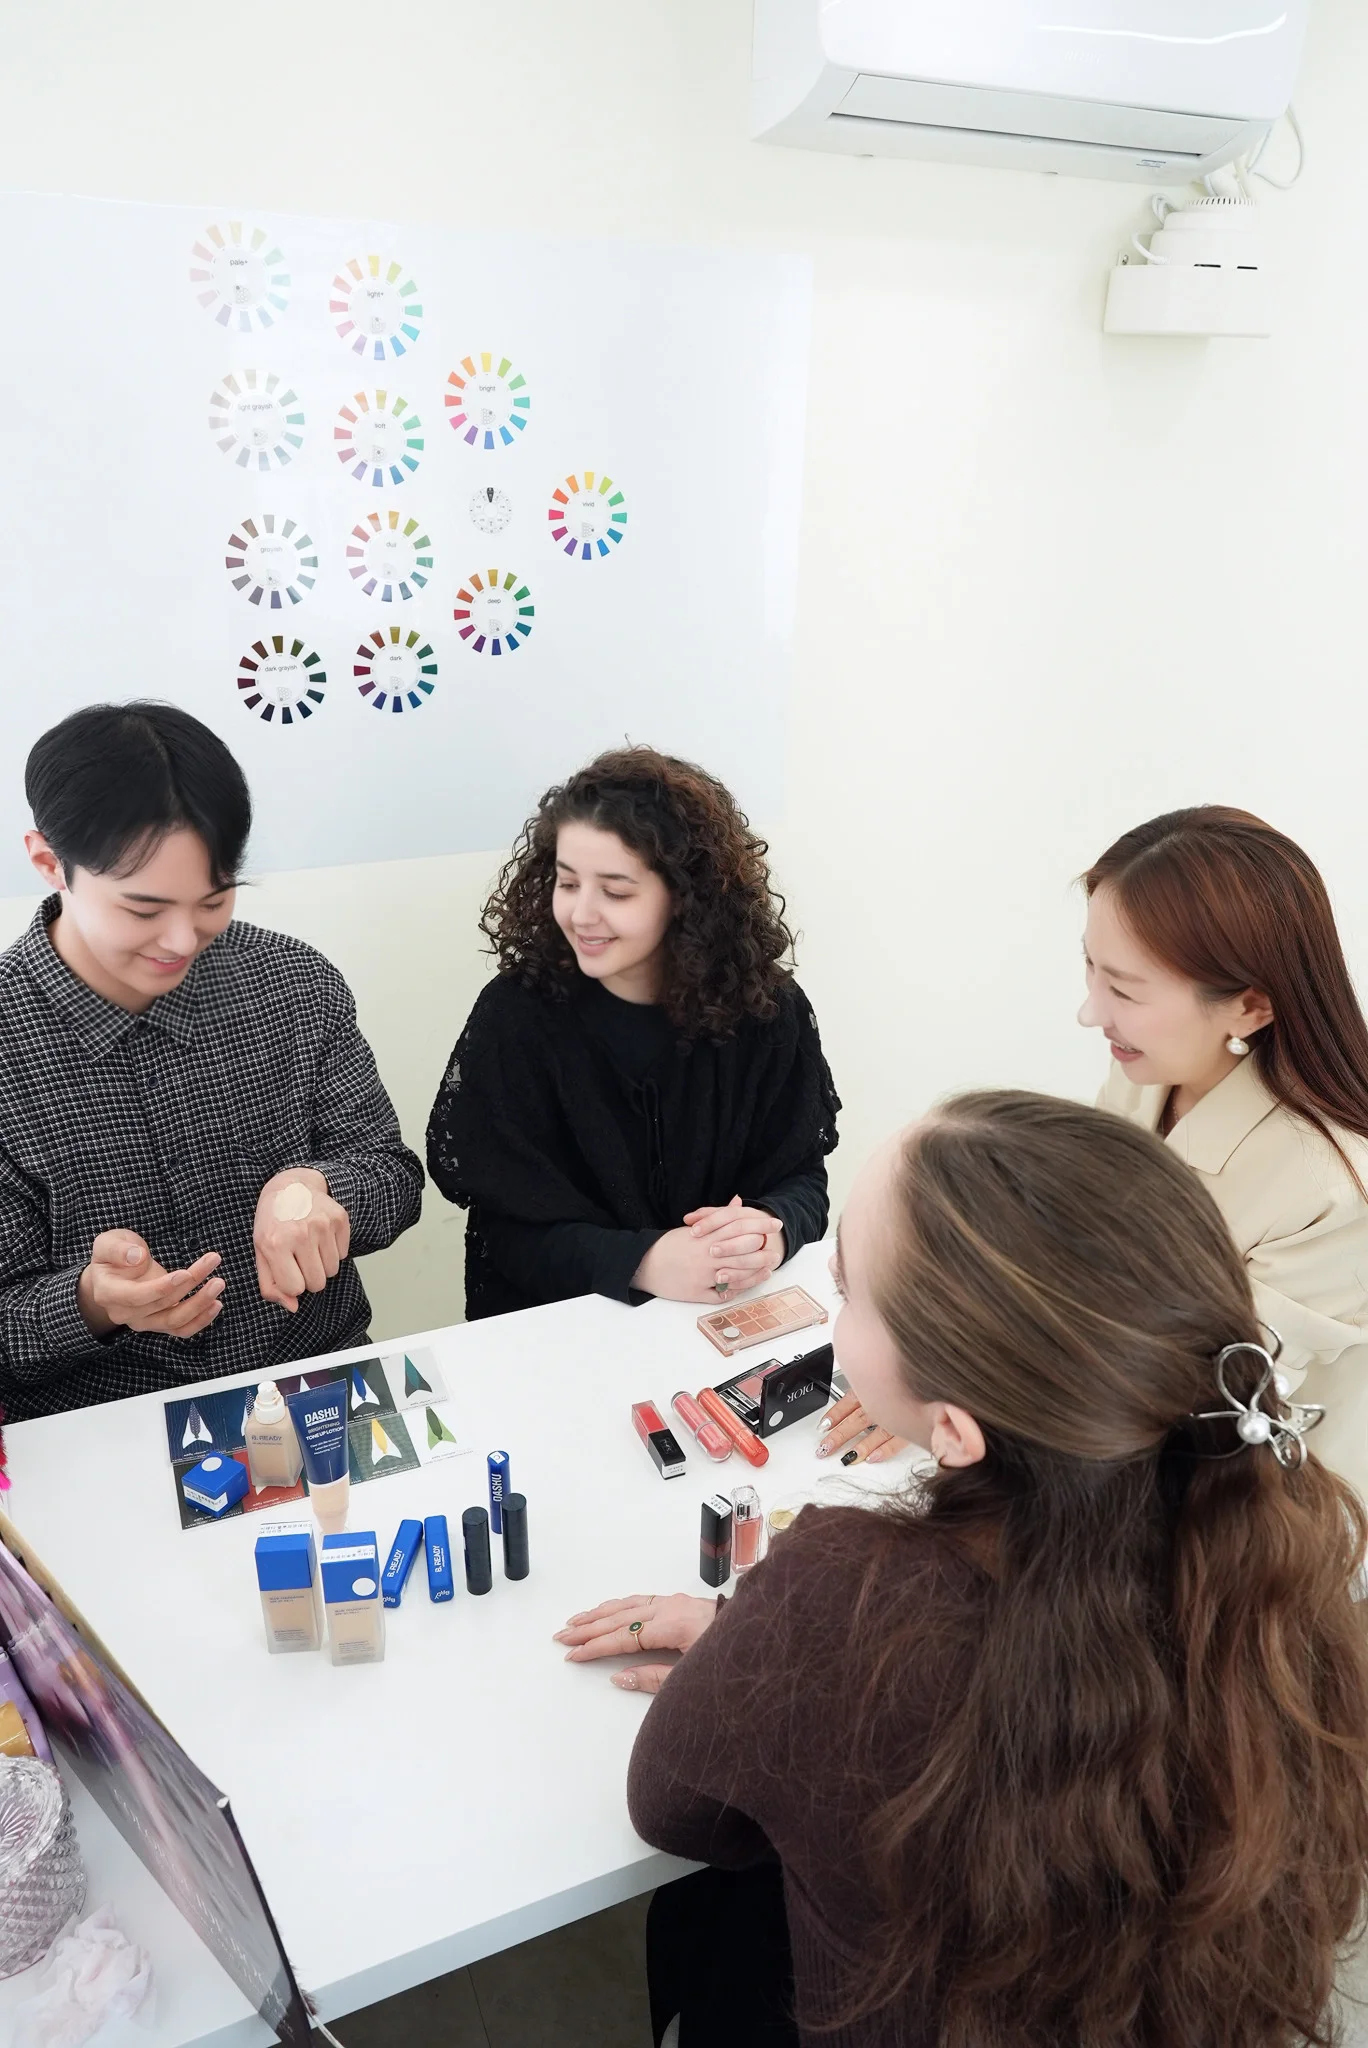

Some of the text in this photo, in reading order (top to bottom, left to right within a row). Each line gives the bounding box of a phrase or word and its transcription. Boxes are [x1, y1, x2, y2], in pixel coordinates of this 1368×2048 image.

[479, 385, 496, 393] bright
[251, 403, 273, 412] grayish
[260, 546, 283, 554] grayish
[278, 664, 298, 673] grayish
[786, 1382, 814, 1403] DIOR
[304, 1406, 339, 1425] DASHU
[308, 1421, 341, 1434] BRIGHTENING
[491, 1473, 503, 1502] DASHU
[389, 1549, 403, 1572] READY
[432, 1545, 442, 1567] READY
